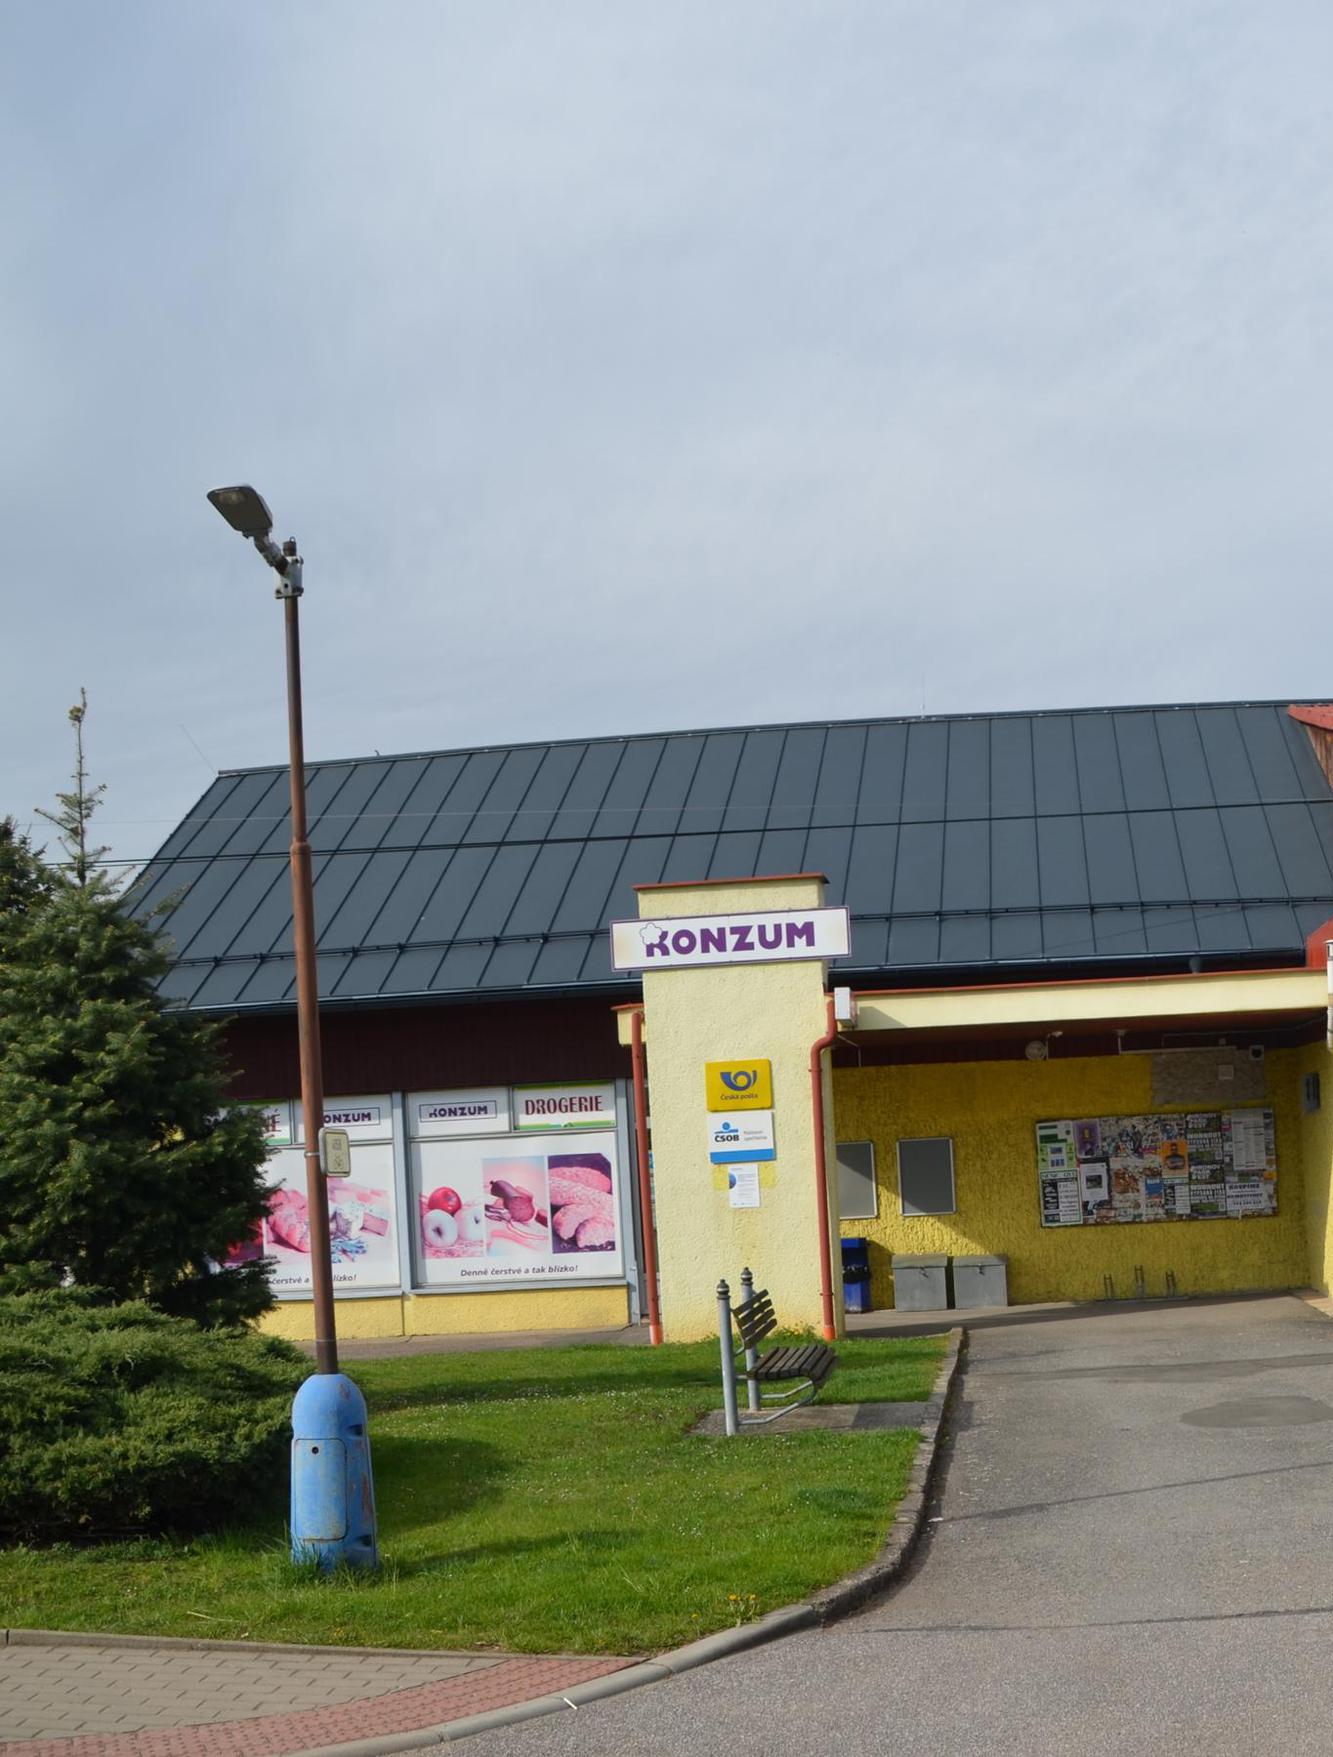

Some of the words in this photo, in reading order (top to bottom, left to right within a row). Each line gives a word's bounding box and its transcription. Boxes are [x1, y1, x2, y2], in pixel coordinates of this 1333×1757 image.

[646, 921, 815, 957] KONZUM
[525, 1095, 603, 1115] DROGERIE
[429, 1105, 488, 1118] KONZUM
[324, 1112, 371, 1124] ONZUM
[460, 1269, 488, 1277] Denně
[491, 1268, 521, 1276] čerstvé
[532, 1266, 545, 1274] tak
[548, 1265, 578, 1273] blízko!
[333, 1274, 357, 1282] lízko!
